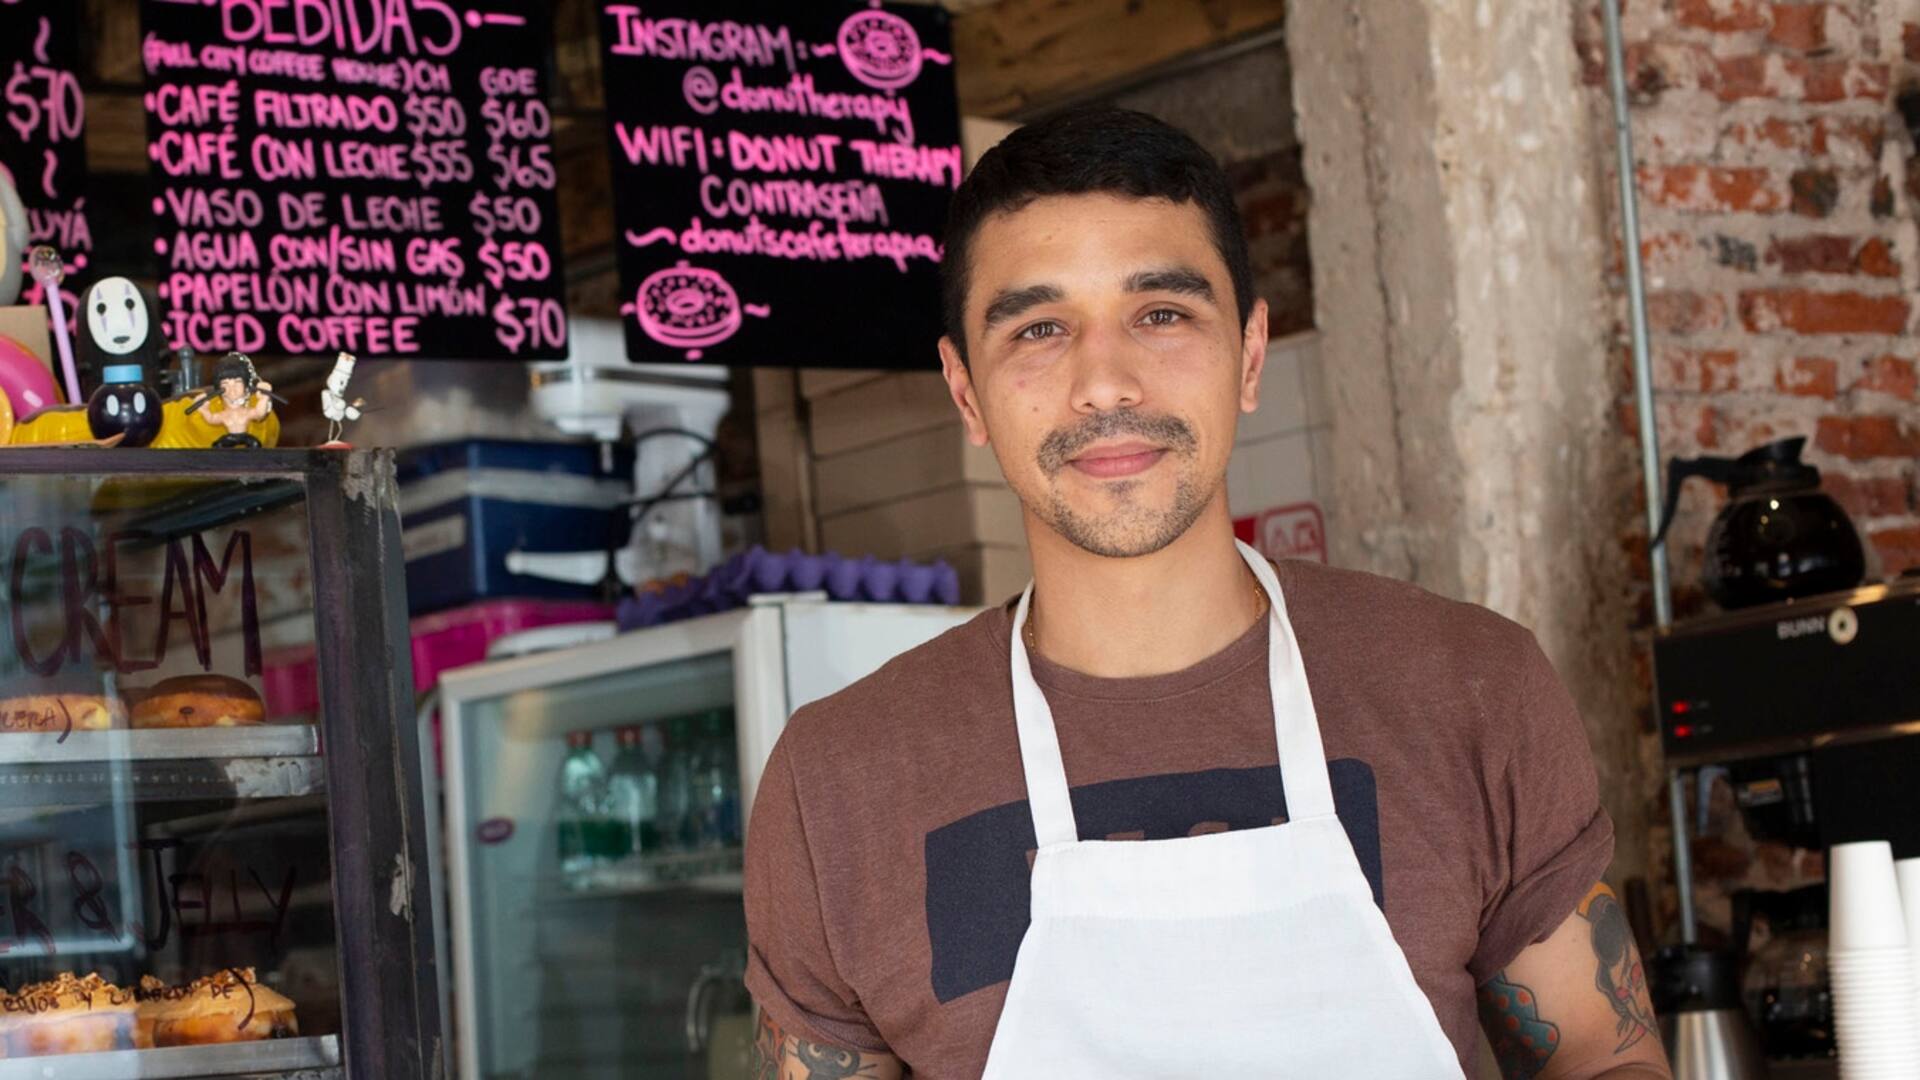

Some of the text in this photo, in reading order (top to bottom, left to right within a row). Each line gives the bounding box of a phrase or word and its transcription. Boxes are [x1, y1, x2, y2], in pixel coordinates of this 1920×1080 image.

[5, 61, 84, 142] $70
[249, 48, 325, 82] COFFEE
[414, 60, 450, 92] CH
[479, 66, 537, 95] GDE
[156, 80, 550, 139] CAFÉ FILTRADO $50 $60
[160, 125, 556, 190] CAFÉ CON LECHE $55 $65
[727, 130, 842, 173] DONUT
[849, 140, 962, 192] THERAPY
[166, 187, 541, 236] VASO DE LECHE $50
[700, 174, 889, 227] CONTRASEÑA
[171, 225, 551, 288] AGUA CON/SIN GAS $50
[170, 268, 487, 316] PAPELÓN CON LIMÓN
[167, 293, 567, 354] ICED COFFEE $70
[10, 526, 263, 678] CREAM
[1777, 616, 1826, 639] BUNN
[66, 850, 121, 943] &
[138, 838, 297, 956] JELLY
